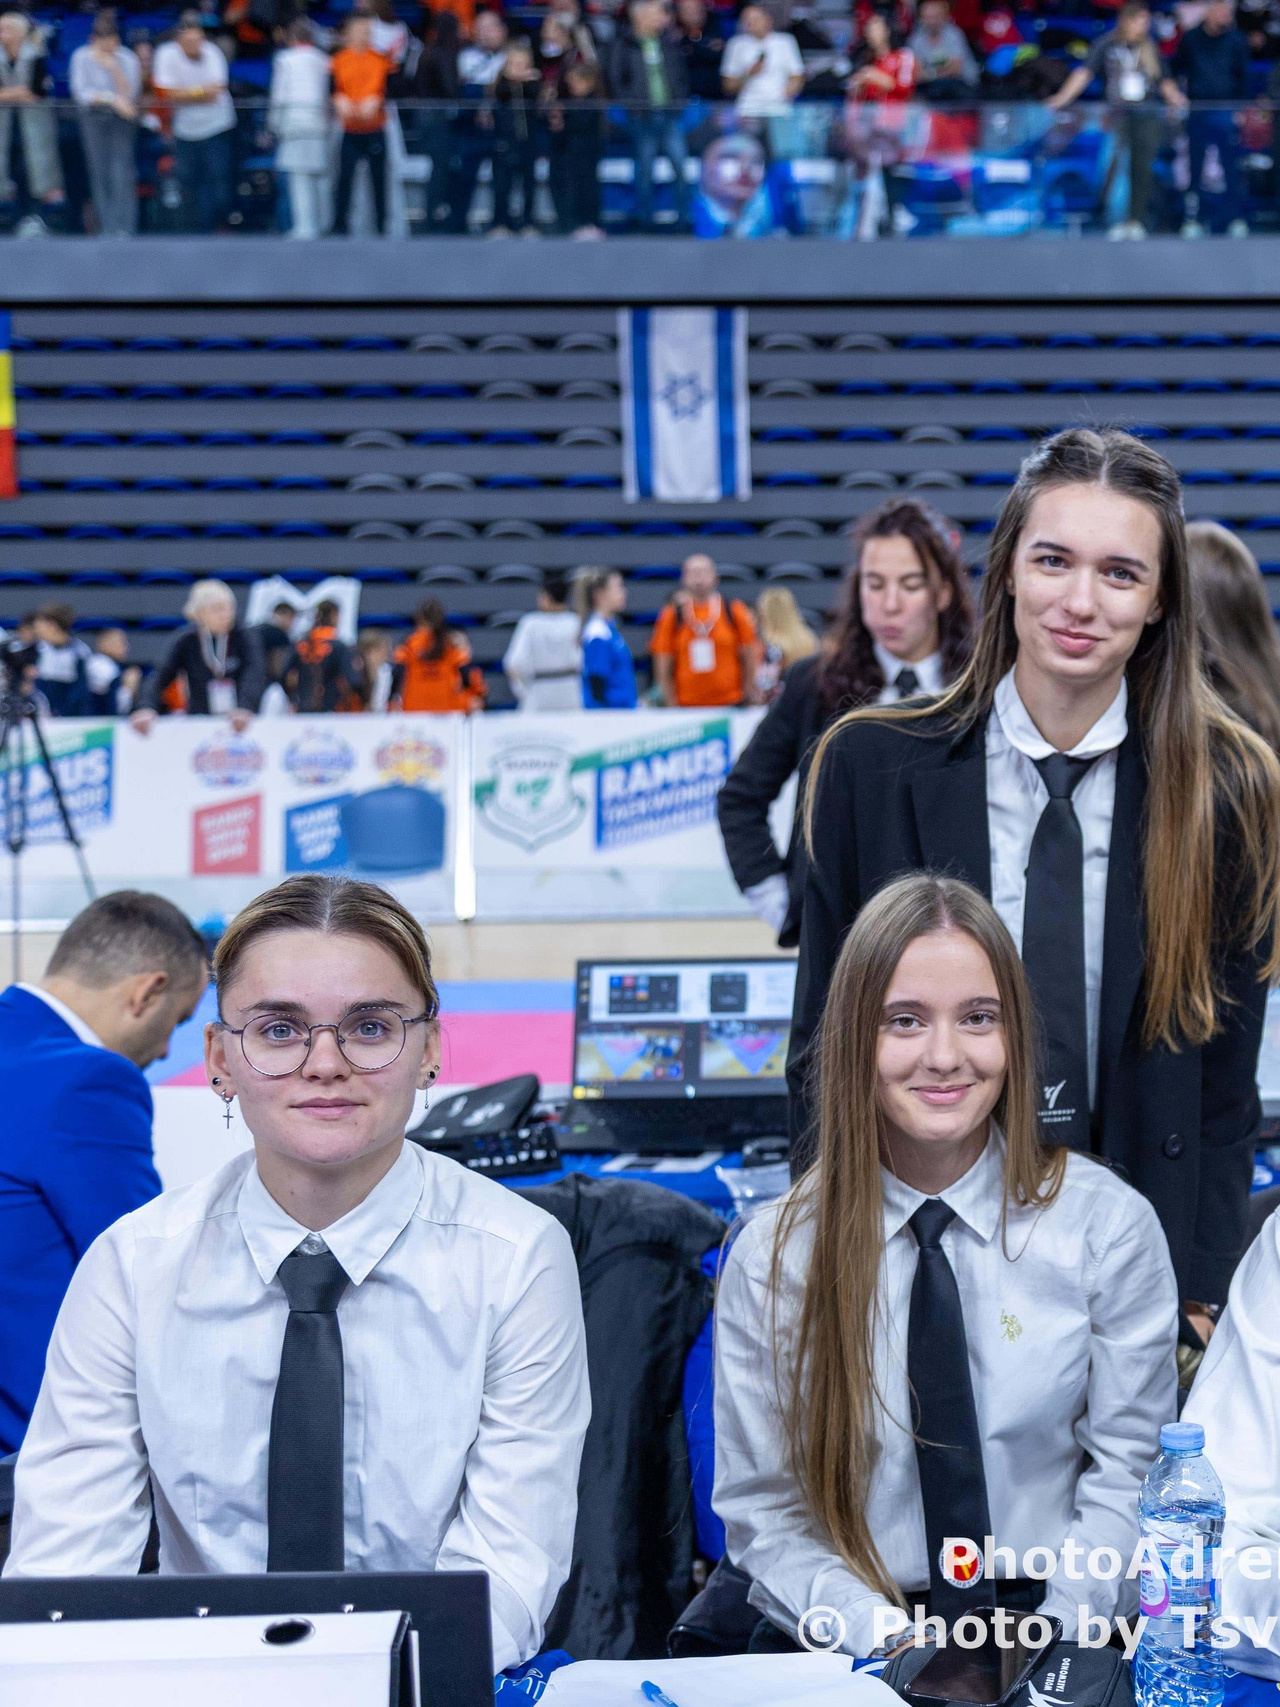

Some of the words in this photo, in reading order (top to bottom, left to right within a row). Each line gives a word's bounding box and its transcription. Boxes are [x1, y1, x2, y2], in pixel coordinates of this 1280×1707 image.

[602, 739, 726, 799] RAMUS
[1043, 1672, 1056, 1691] WORLD
[1055, 1657, 1071, 1692] TAEKWONDO
